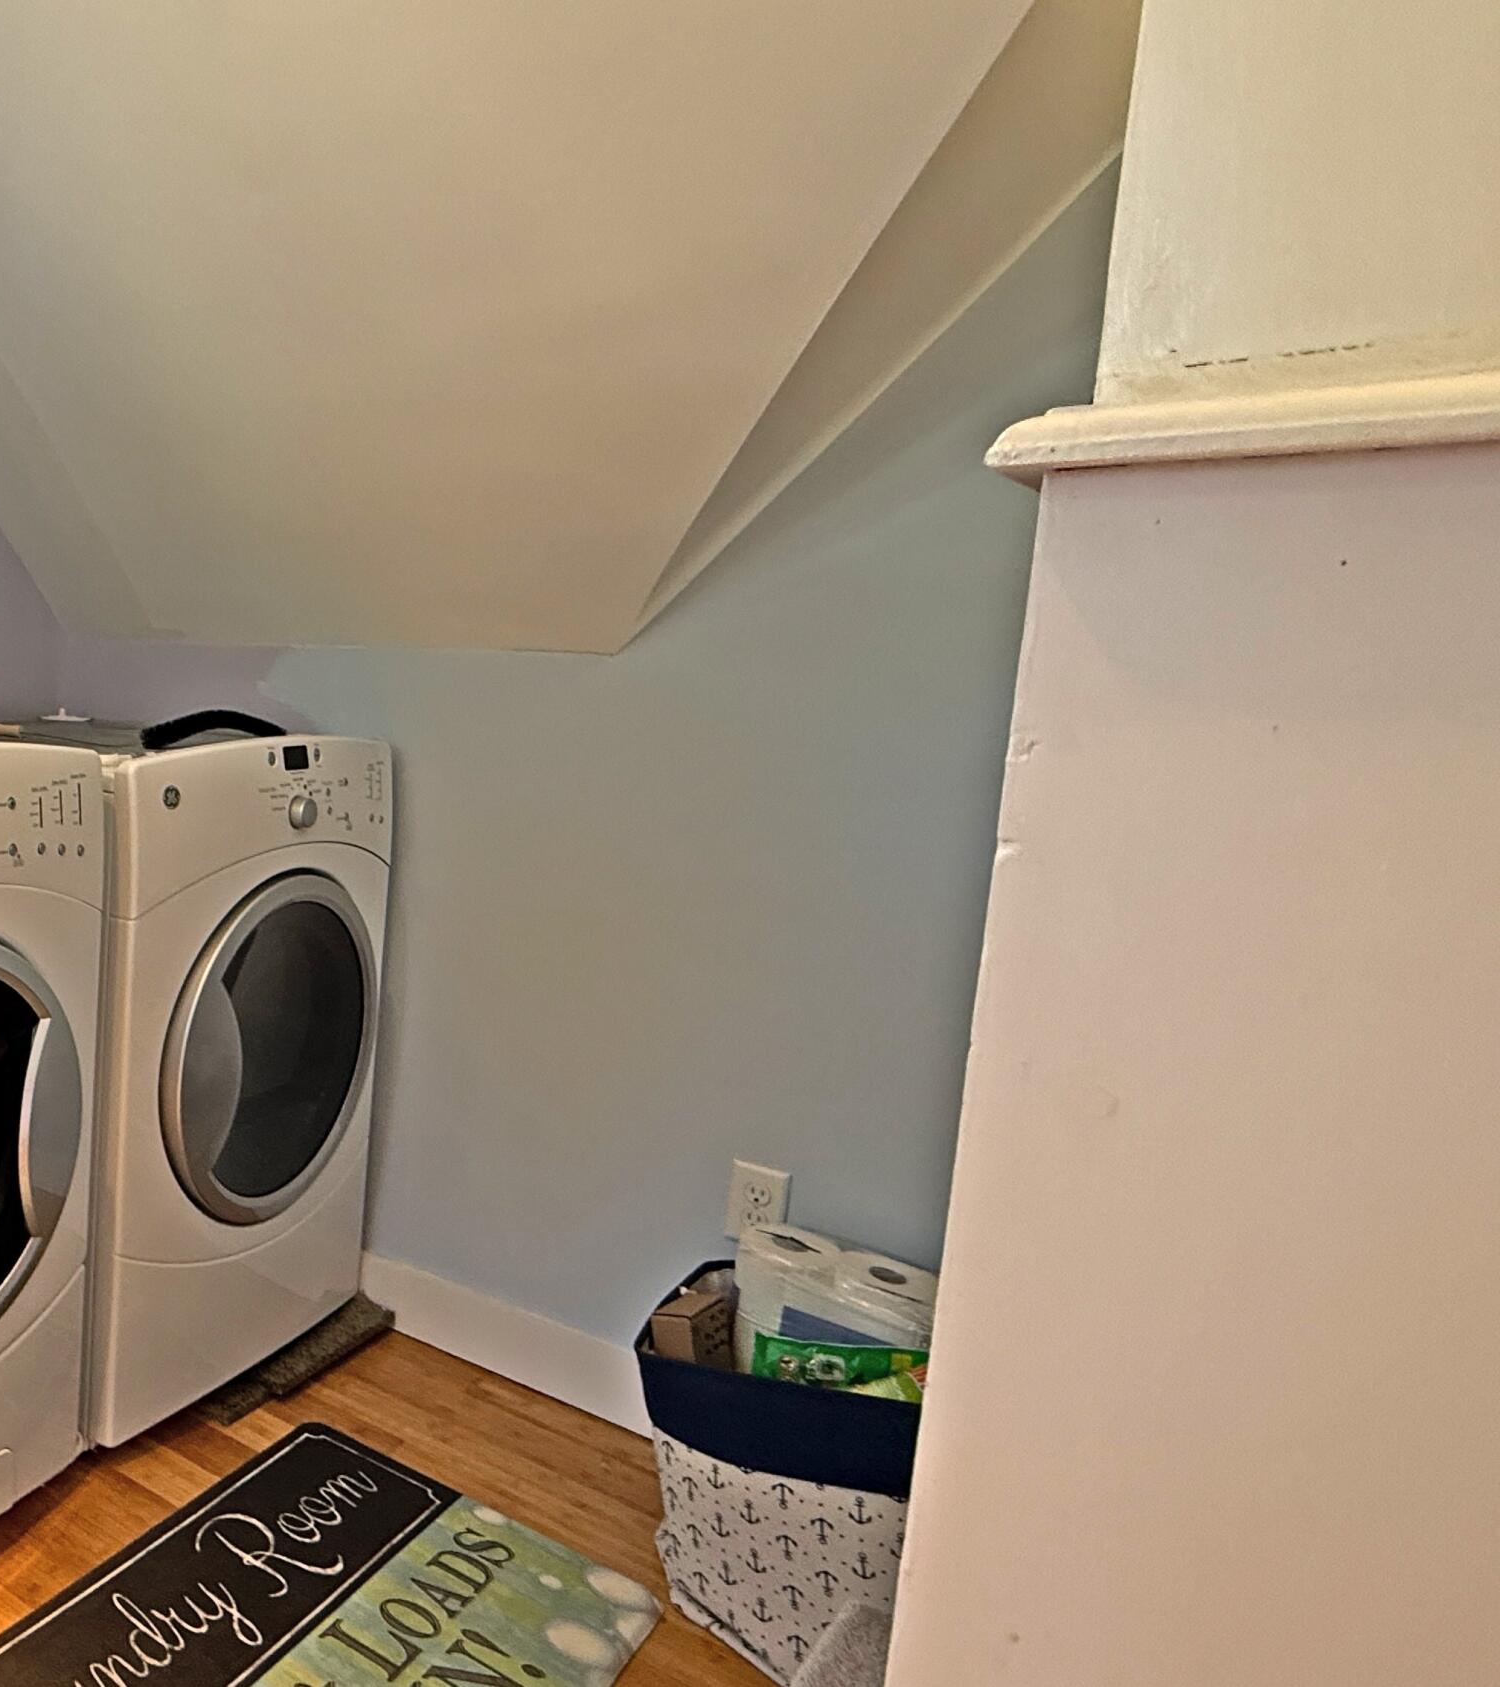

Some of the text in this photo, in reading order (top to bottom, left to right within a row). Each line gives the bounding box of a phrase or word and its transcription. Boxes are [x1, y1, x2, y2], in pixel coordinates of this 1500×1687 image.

[75, 1470, 378, 1687] ndry Room
[319, 1527, 515, 1682] LOADS
